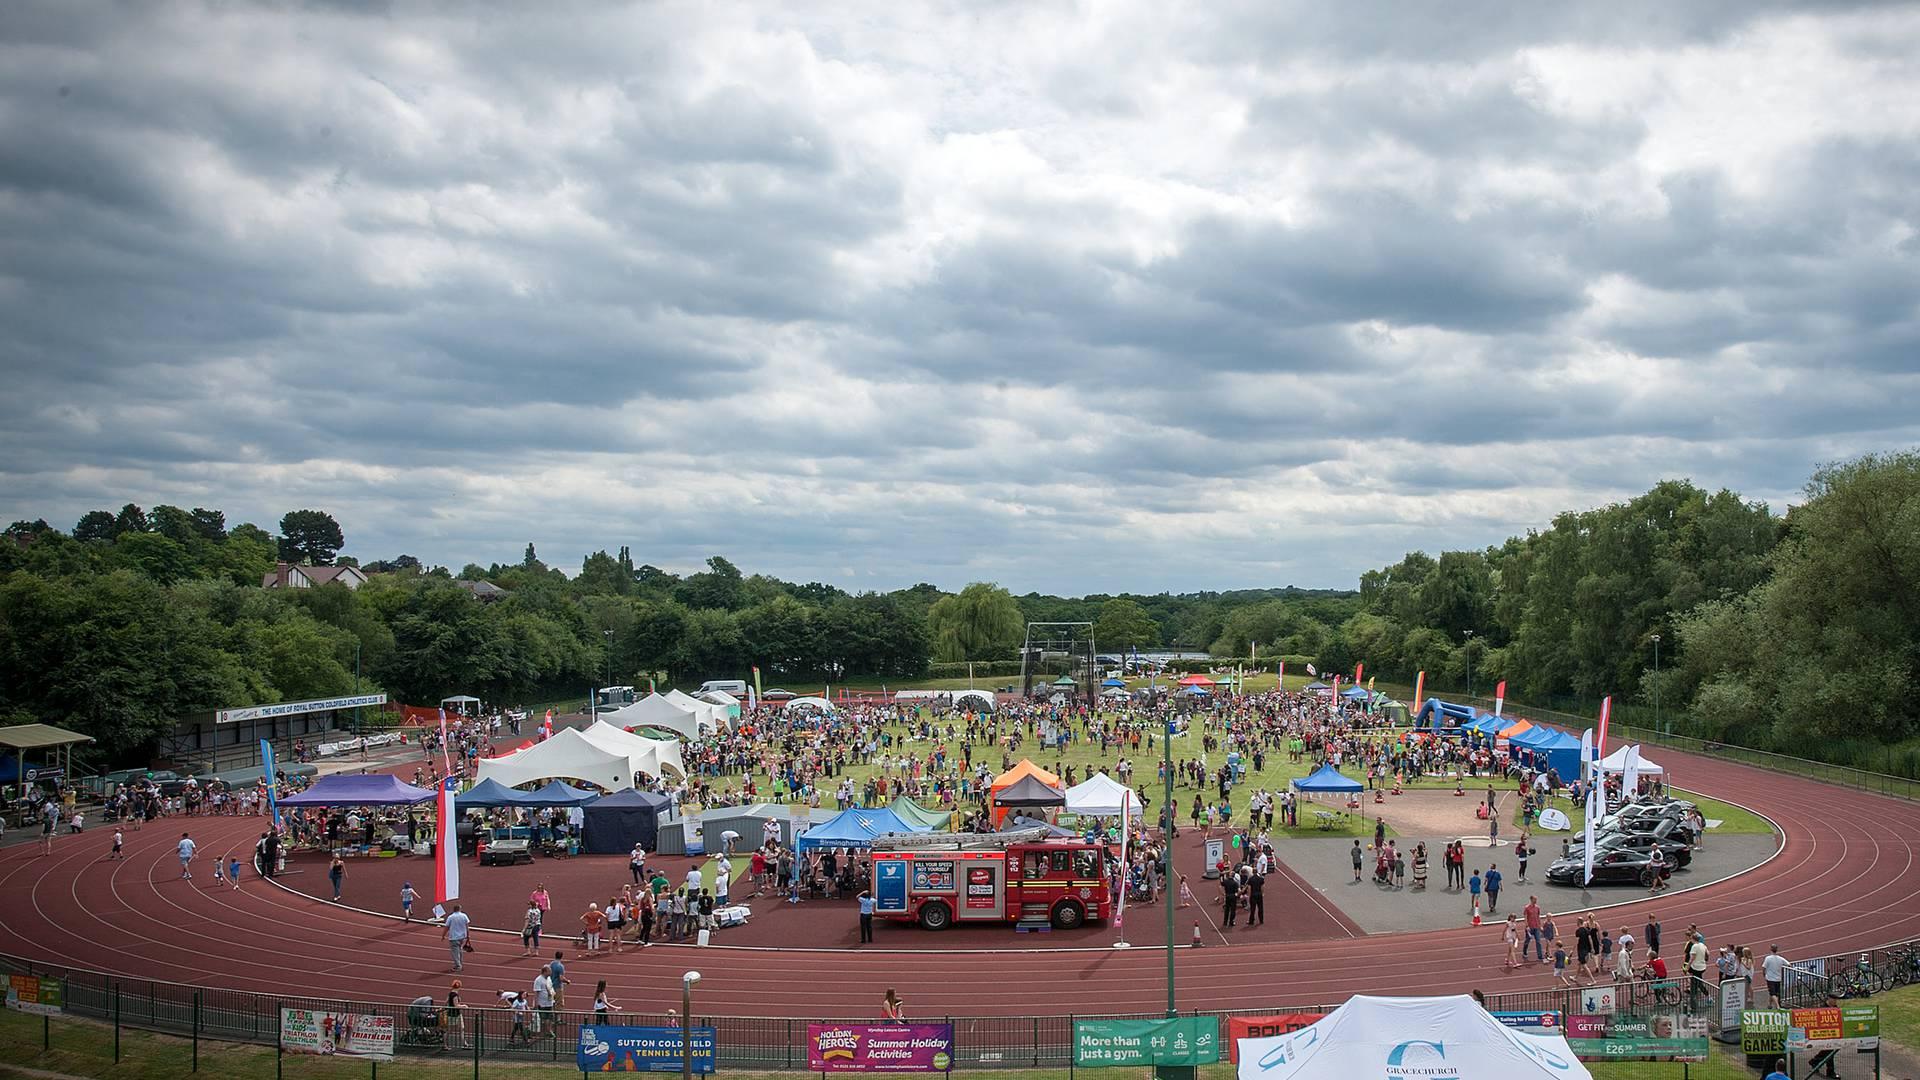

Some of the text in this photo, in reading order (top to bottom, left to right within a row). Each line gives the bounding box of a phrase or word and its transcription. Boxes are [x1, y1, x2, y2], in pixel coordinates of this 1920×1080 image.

[326, 700, 346, 708] COLDFIELD
[1743, 1012, 1790, 1025] SUTTON
[1821, 1015, 1839, 1023] JULY
[1248, 1024, 1312, 1037] BOLD
[1746, 1025, 1784, 1033] COLDFIELD
[352, 1032, 392, 1040] TRIATHLON
[820, 1030, 852, 1039] HOLIDAY
[818, 1038, 857, 1050] HEROES
[868, 1039, 948, 1049] Summer Holiday
[1081, 1036, 1140, 1046] More than
[1744, 1040, 1786, 1052] GAMES
[867, 1050, 912, 1058] Activities
[1080, 1048, 1102, 1061] just
[1114, 1050, 1142, 1060] gym.
